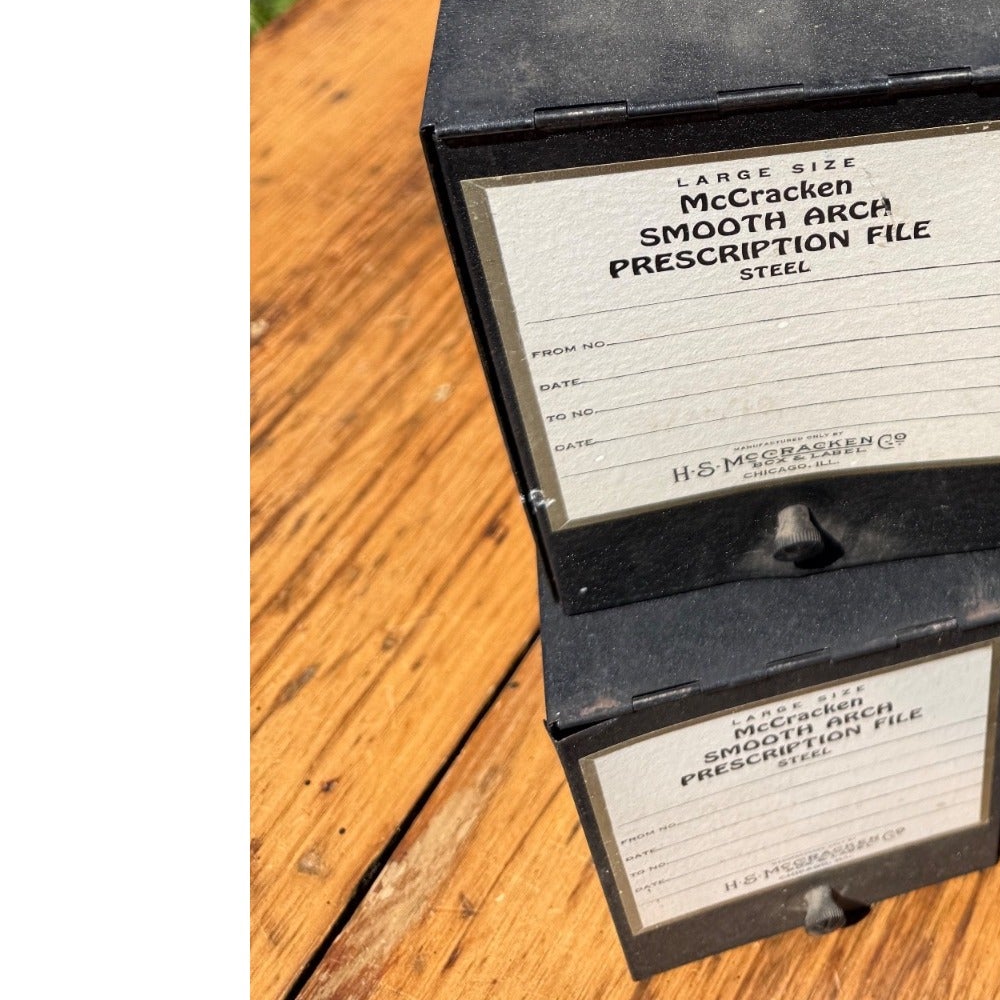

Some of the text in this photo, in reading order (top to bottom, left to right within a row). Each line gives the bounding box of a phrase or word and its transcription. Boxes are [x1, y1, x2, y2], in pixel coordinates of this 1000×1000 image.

[677, 157, 856, 188] LARGE SIZE
[680, 179, 853, 214] McCracken
[640, 197, 892, 247] SMOOTH ARCH
[609, 219, 931, 279] PRESCRIPTION FILE
[739, 260, 811, 281] STEEL
[531, 345, 577, 358] FROM
[540, 378, 580, 392] DATE
[545, 413, 567, 423] TO
[554, 438, 594, 452] DATE
[752, 456, 787, 468] BOX
[731, 685, 866, 726] LARGE SIZE
[733, 697, 864, 740] McCracken
[704, 701, 894, 764] SMOOTH ARCH
[680, 706, 923, 787] PRESCRIPTION FILE
[777, 747, 832, 768] STEEL
[620, 829, 655, 845] FROM
[625, 848, 657, 862] DATE
